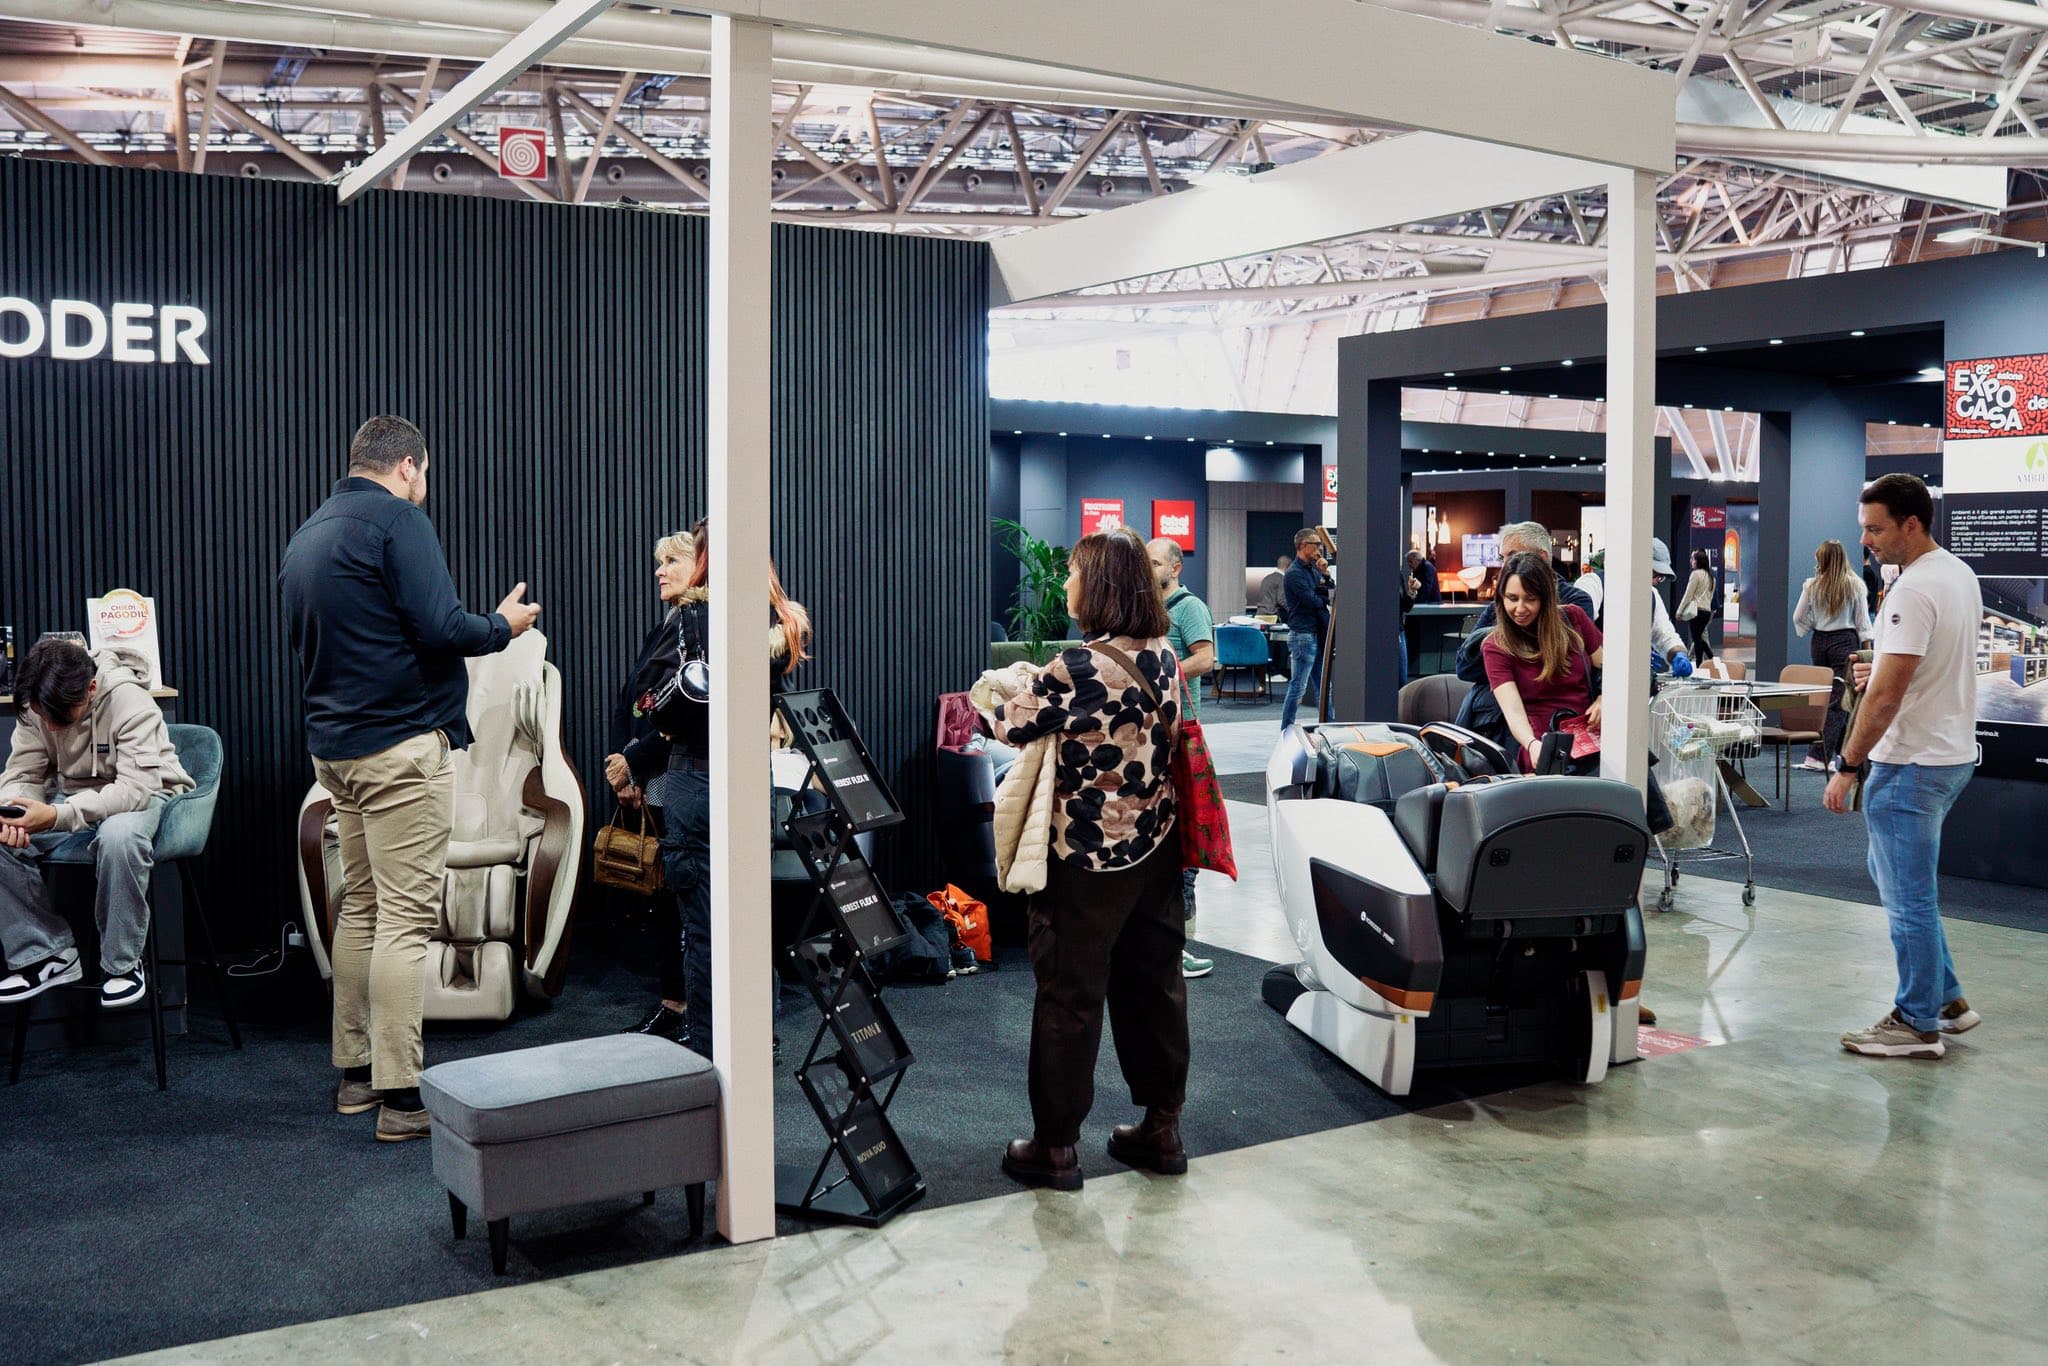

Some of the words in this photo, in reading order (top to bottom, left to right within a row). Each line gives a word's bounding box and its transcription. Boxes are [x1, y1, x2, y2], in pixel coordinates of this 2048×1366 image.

[1976, 364, 1995, 375] 62°
[1954, 369, 2016, 408] EXPO
[2027, 395, 2048, 411] de
[1956, 395, 2023, 431] CASA
[101, 611, 147, 619] PAGODIL
[850, 1024, 876, 1044] TITAN
